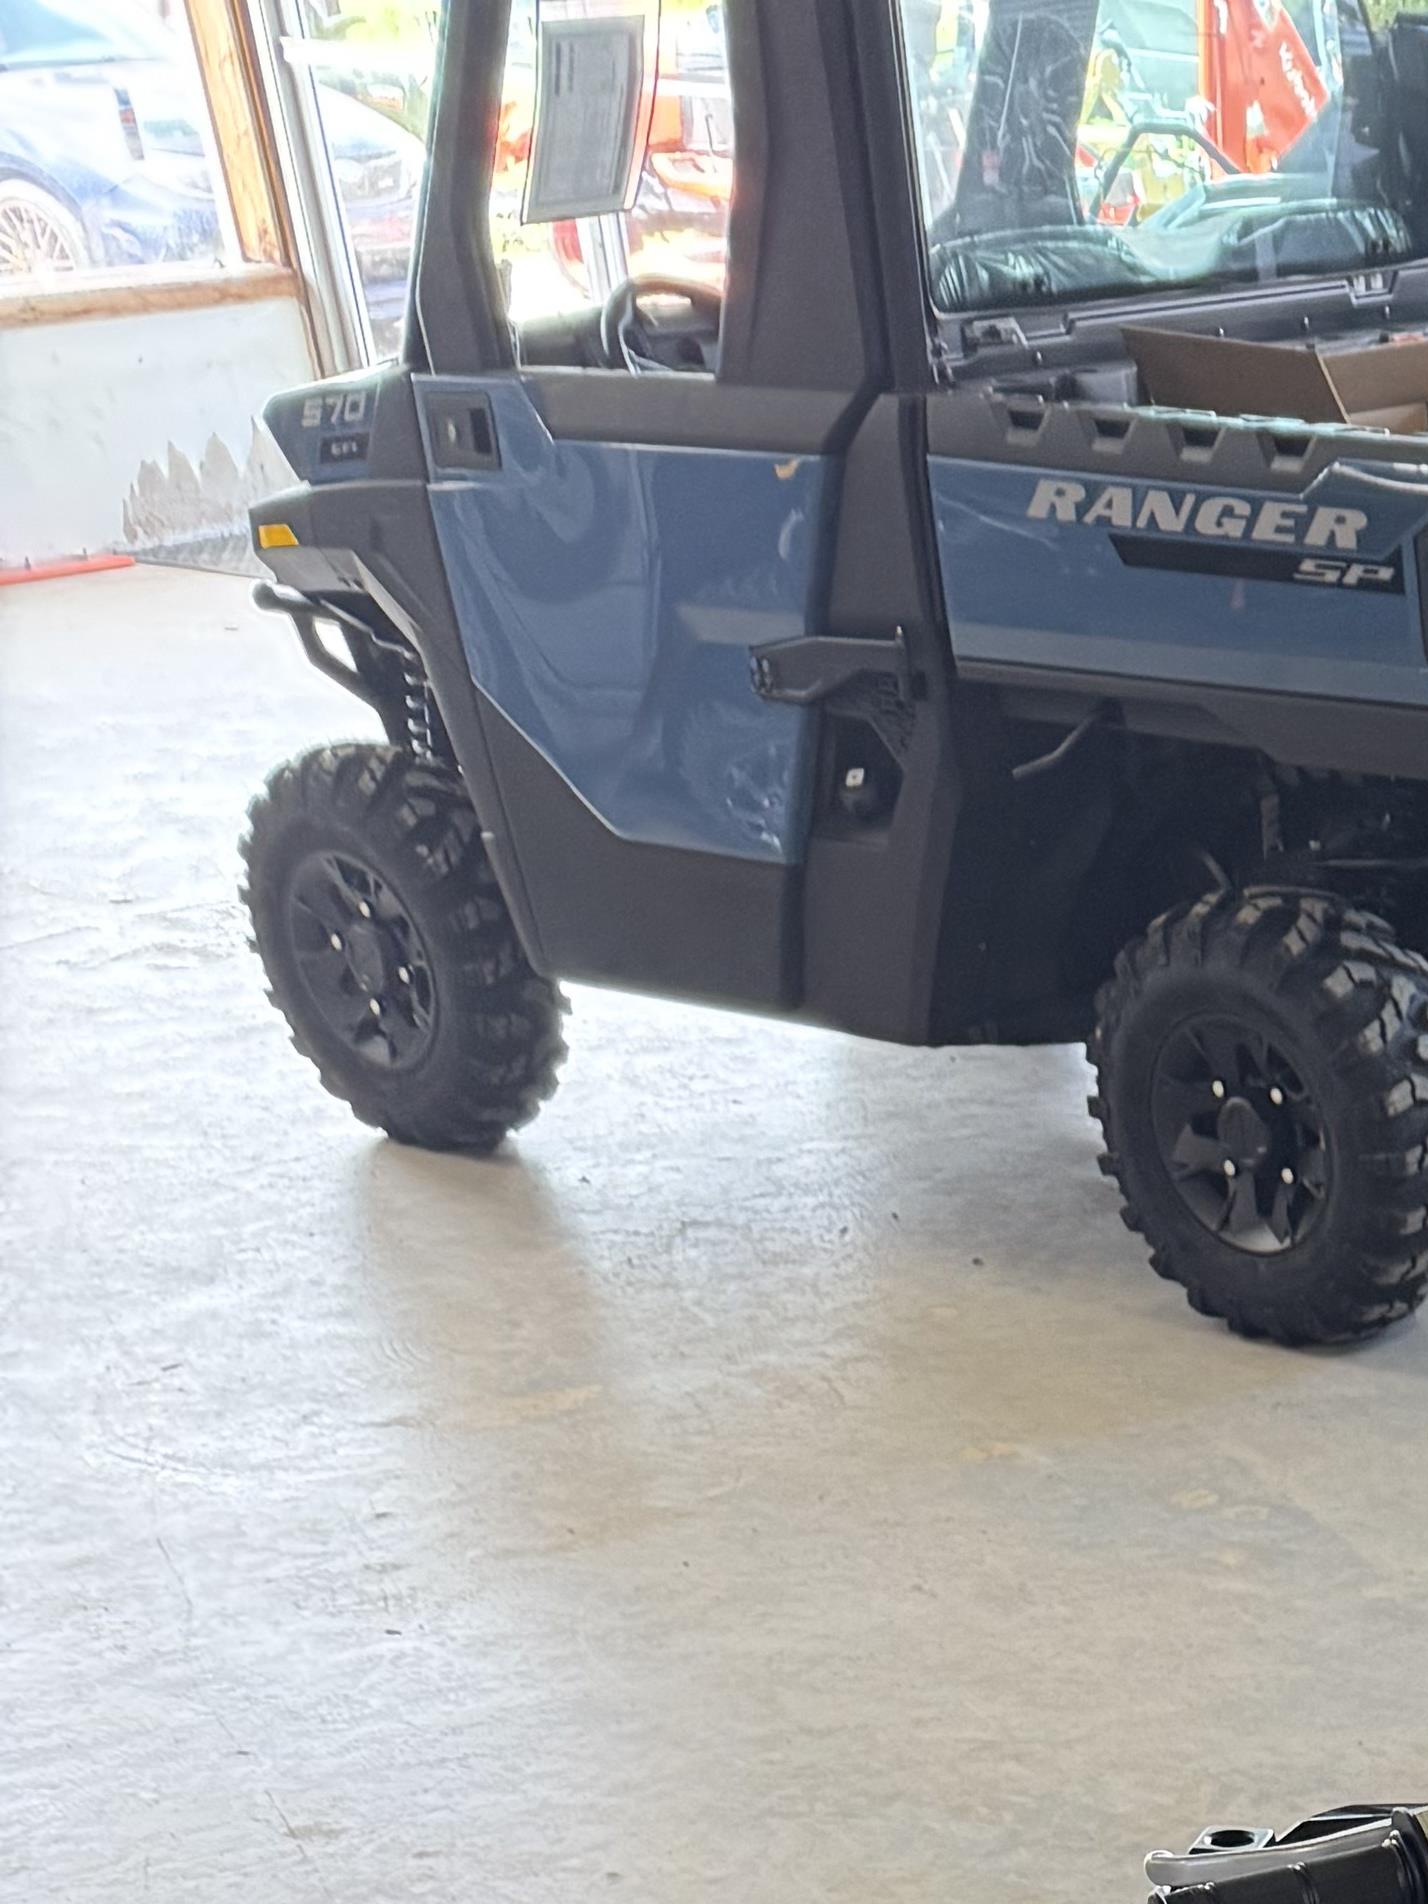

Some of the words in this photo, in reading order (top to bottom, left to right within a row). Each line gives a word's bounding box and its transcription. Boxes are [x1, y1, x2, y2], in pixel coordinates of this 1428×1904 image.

[301, 391, 367, 428] 570
[1026, 478, 1368, 551] RANGER
[1293, 558, 1395, 587] SP
